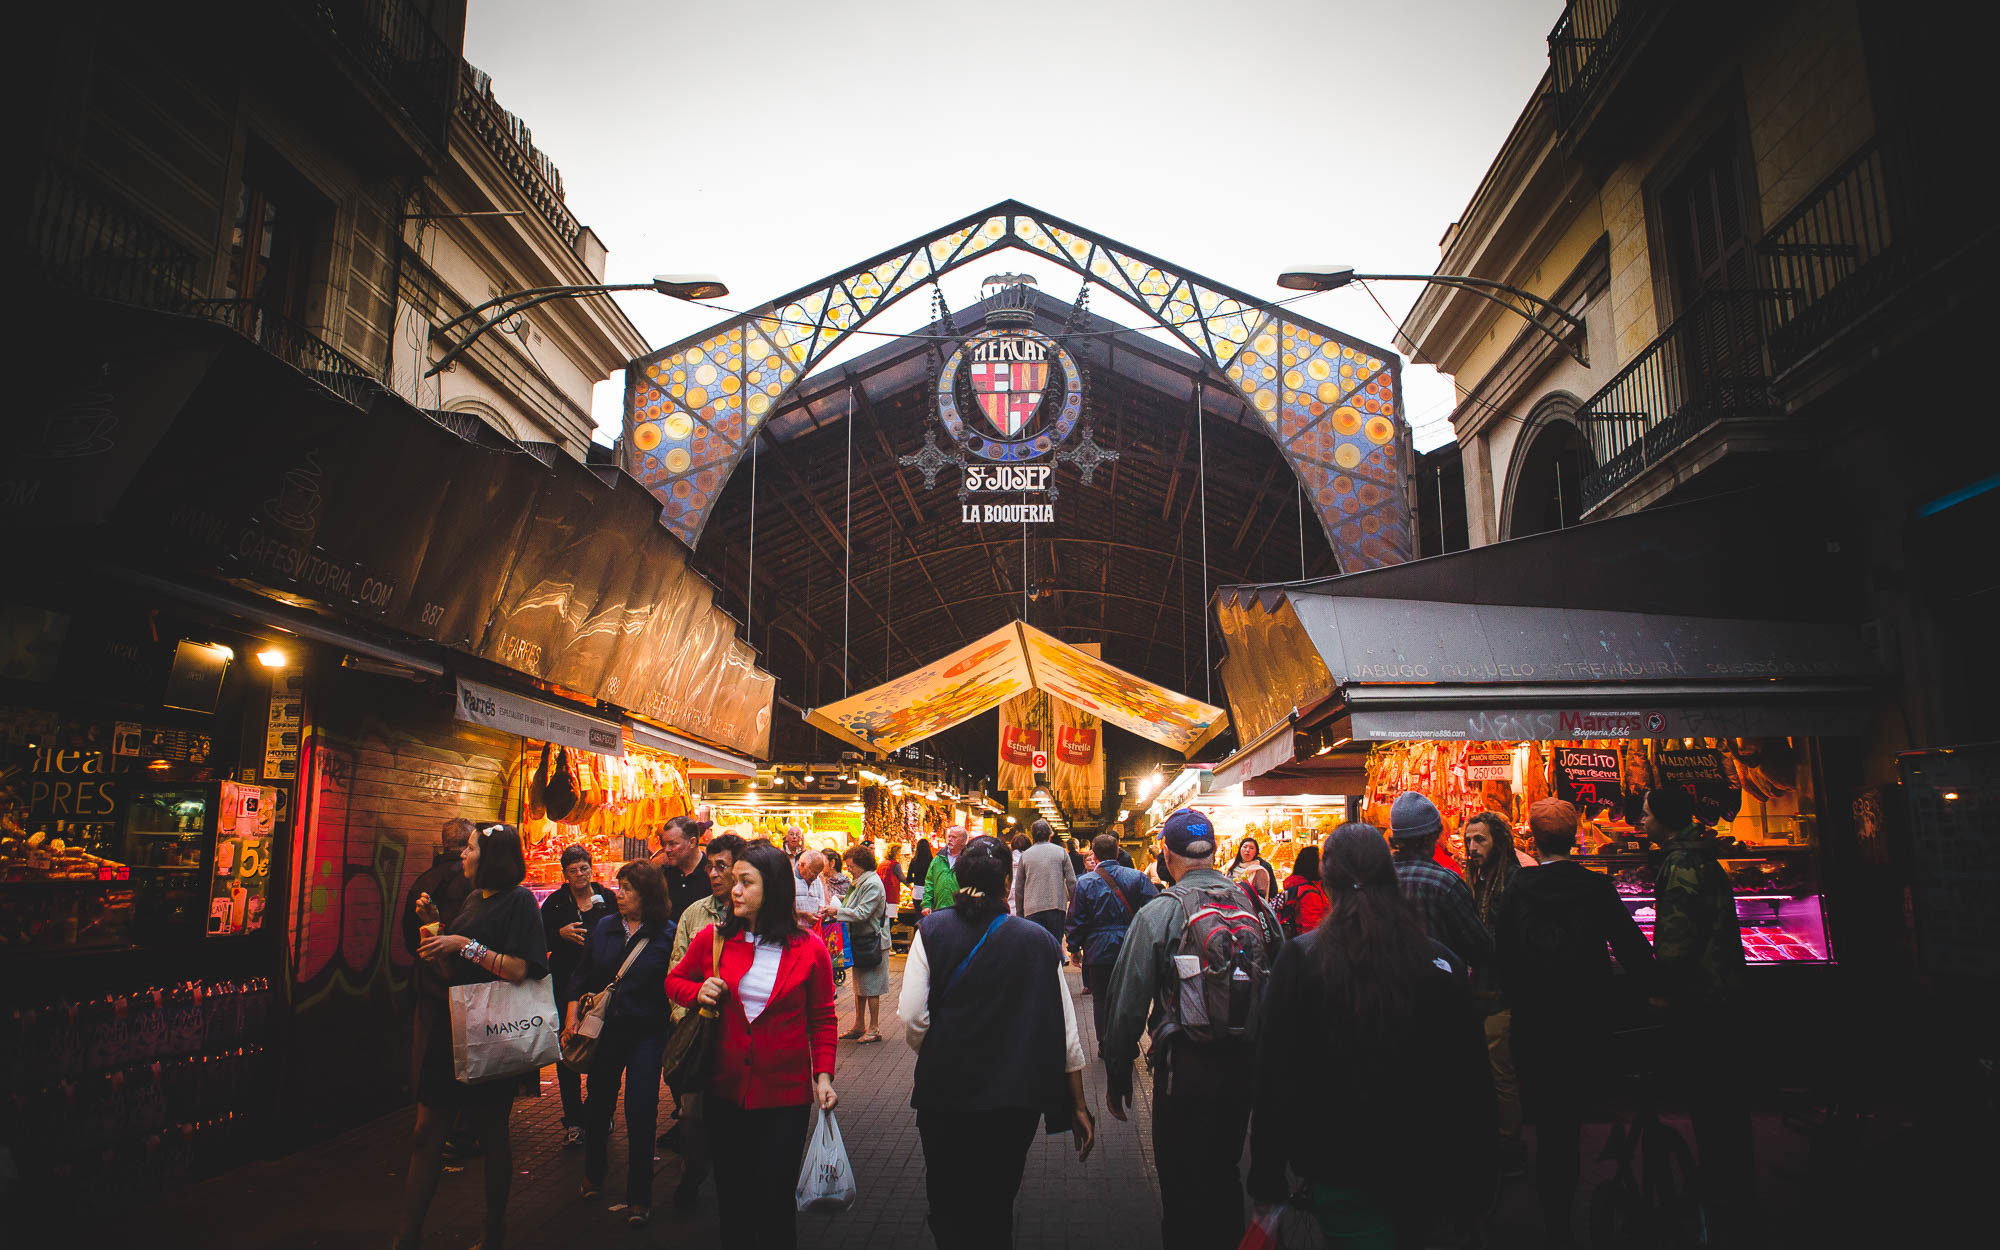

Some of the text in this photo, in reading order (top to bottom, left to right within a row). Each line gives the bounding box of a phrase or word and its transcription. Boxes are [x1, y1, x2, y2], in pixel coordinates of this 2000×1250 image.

[974, 337, 1047, 361] MERCAT
[985, 466, 1051, 491] JOSEP
[962, 505, 1055, 523] LA BOQUERIA
[421, 602, 445, 627] 887
[507, 635, 542, 665] FARRES
[1352, 664, 1429, 678] JABUGO
[1559, 711, 1641, 731] Marcos
[1007, 739, 1036, 752] Estrella
[1062, 739, 1091, 752] Estrella
[1036, 756, 1043, 766] 6
[1569, 783, 1597, 803] 79
[486, 1015, 544, 1037] MANGO
